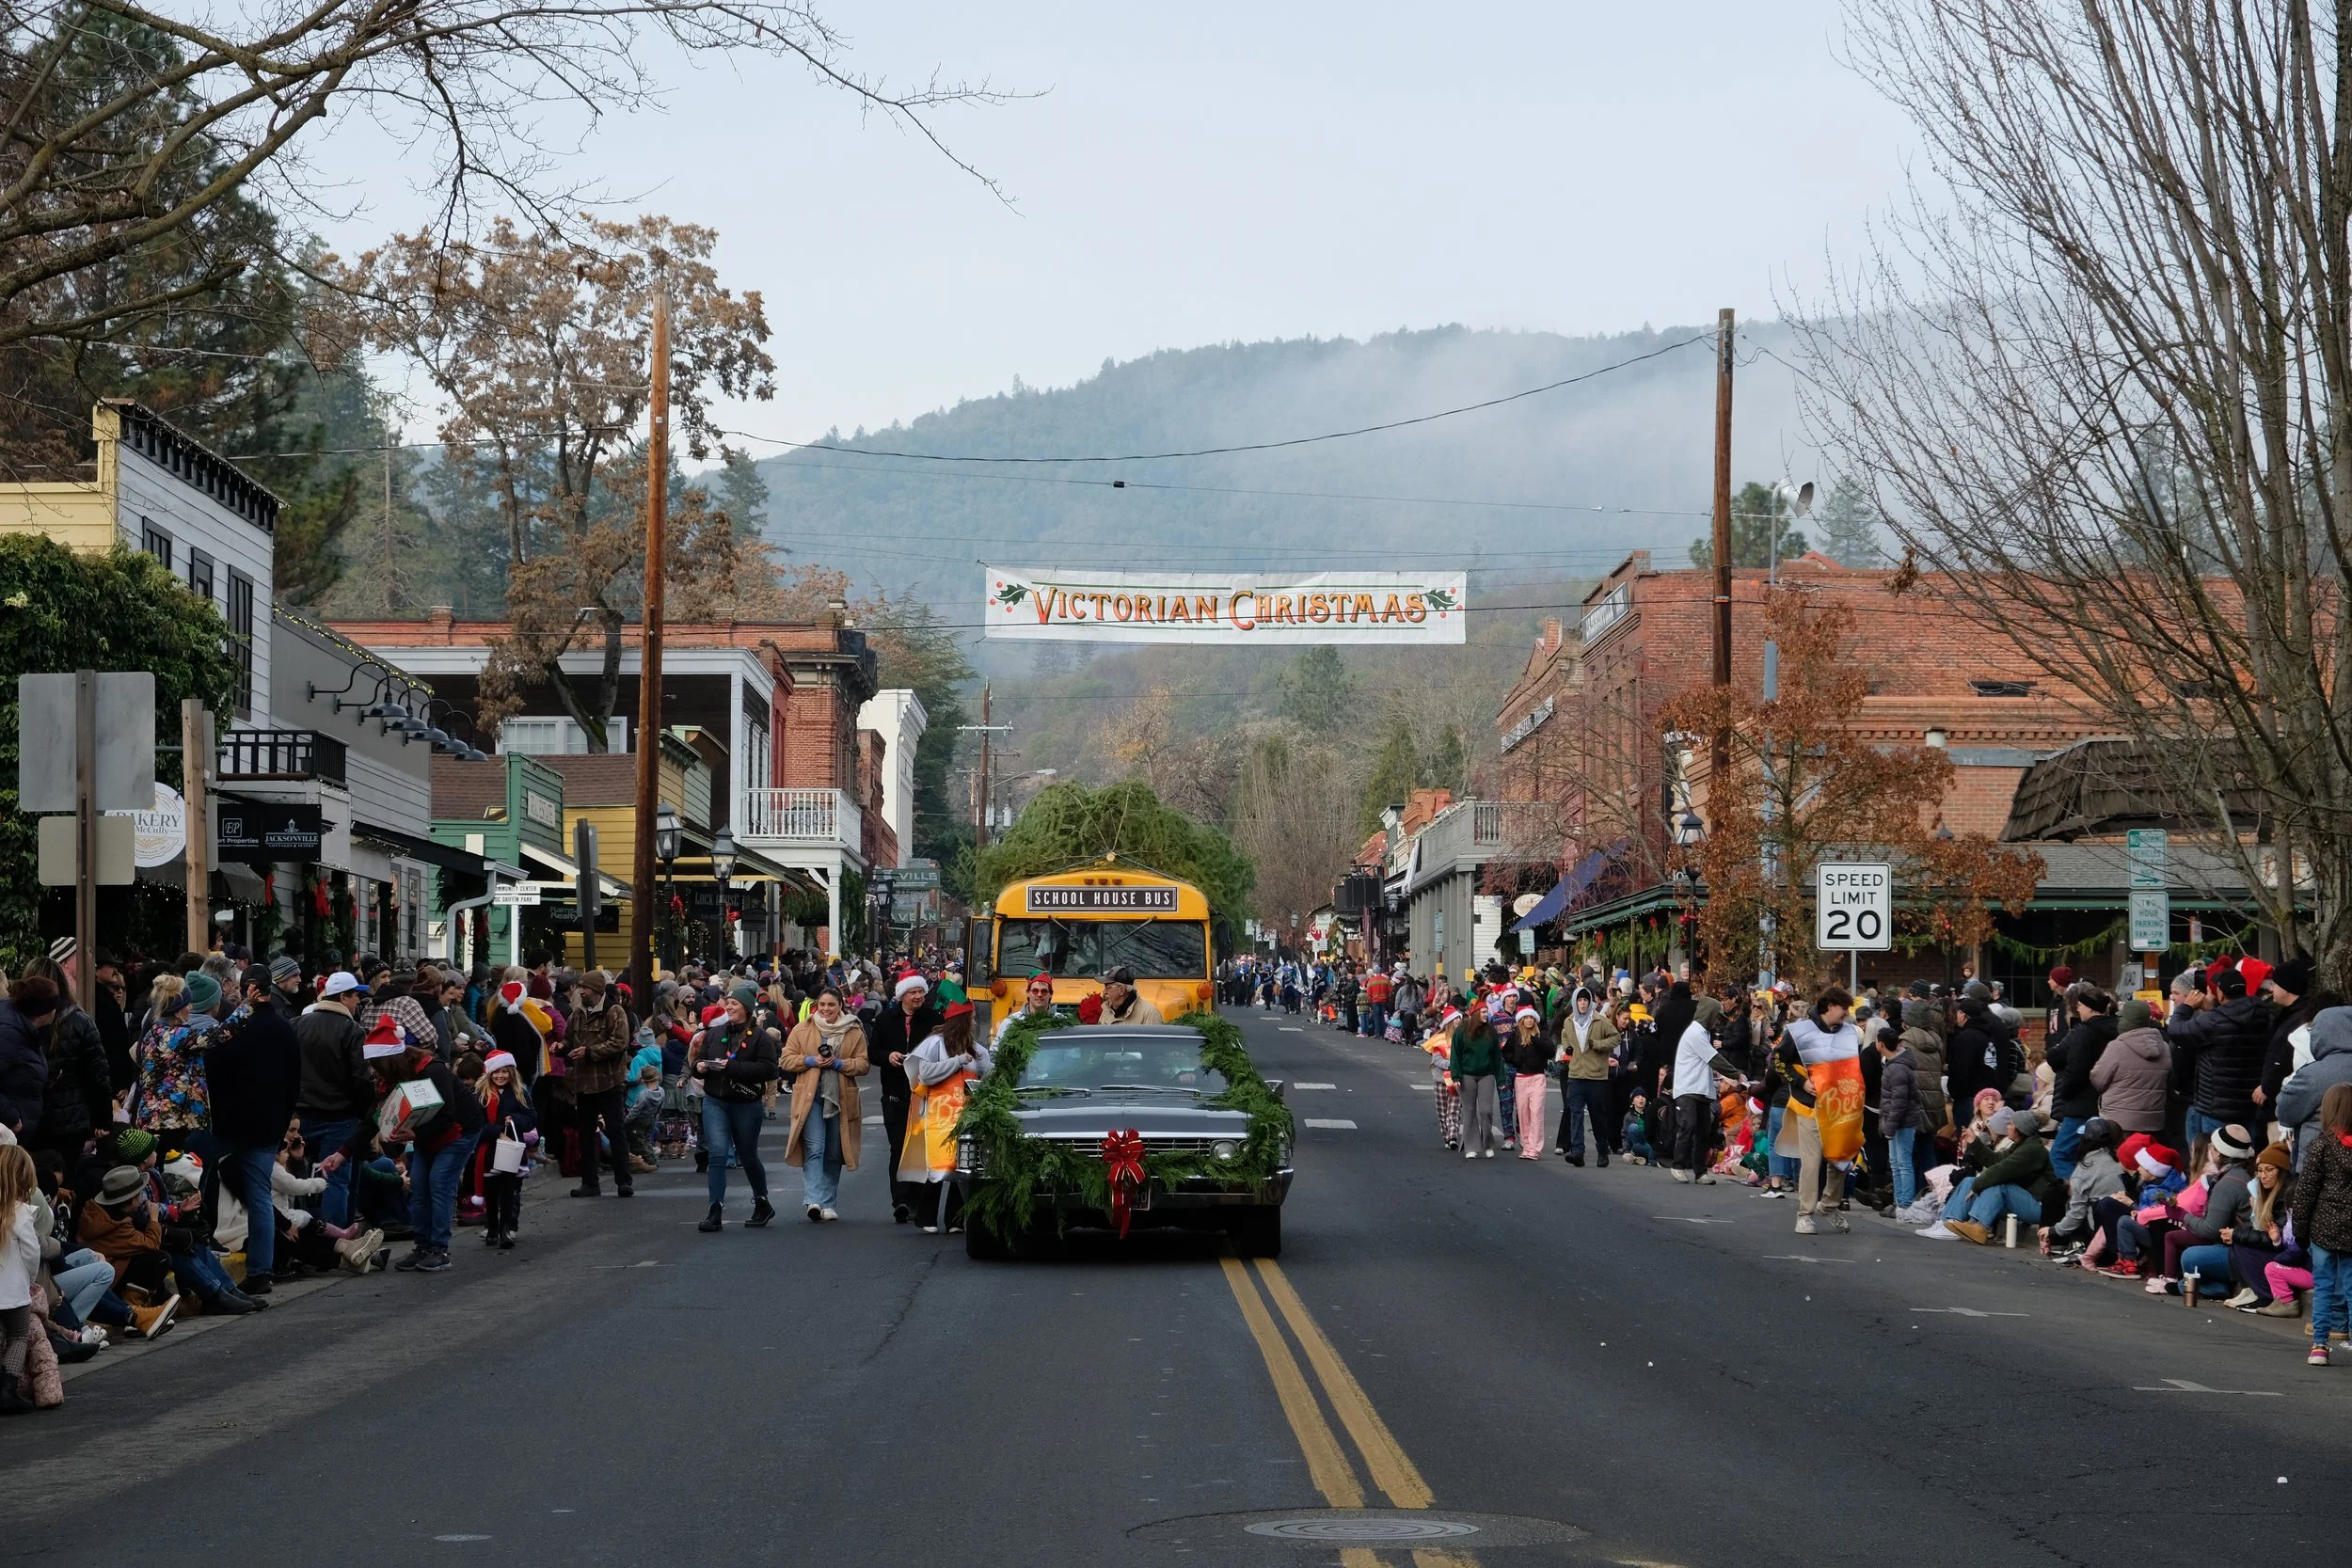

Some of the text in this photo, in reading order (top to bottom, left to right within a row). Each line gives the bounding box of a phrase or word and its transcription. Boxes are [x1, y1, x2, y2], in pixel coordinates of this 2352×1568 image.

[1031, 587, 1426, 630] VICTORIAN CHRISTMAS
[116, 812, 181, 827] KERY
[1825, 874, 1883, 886] SPEED
[1035, 892, 1169, 905] SCHOOL HOUSE BUS
[1831, 892, 1877, 904] LIMIT
[1827, 910, 1881, 940] 20
